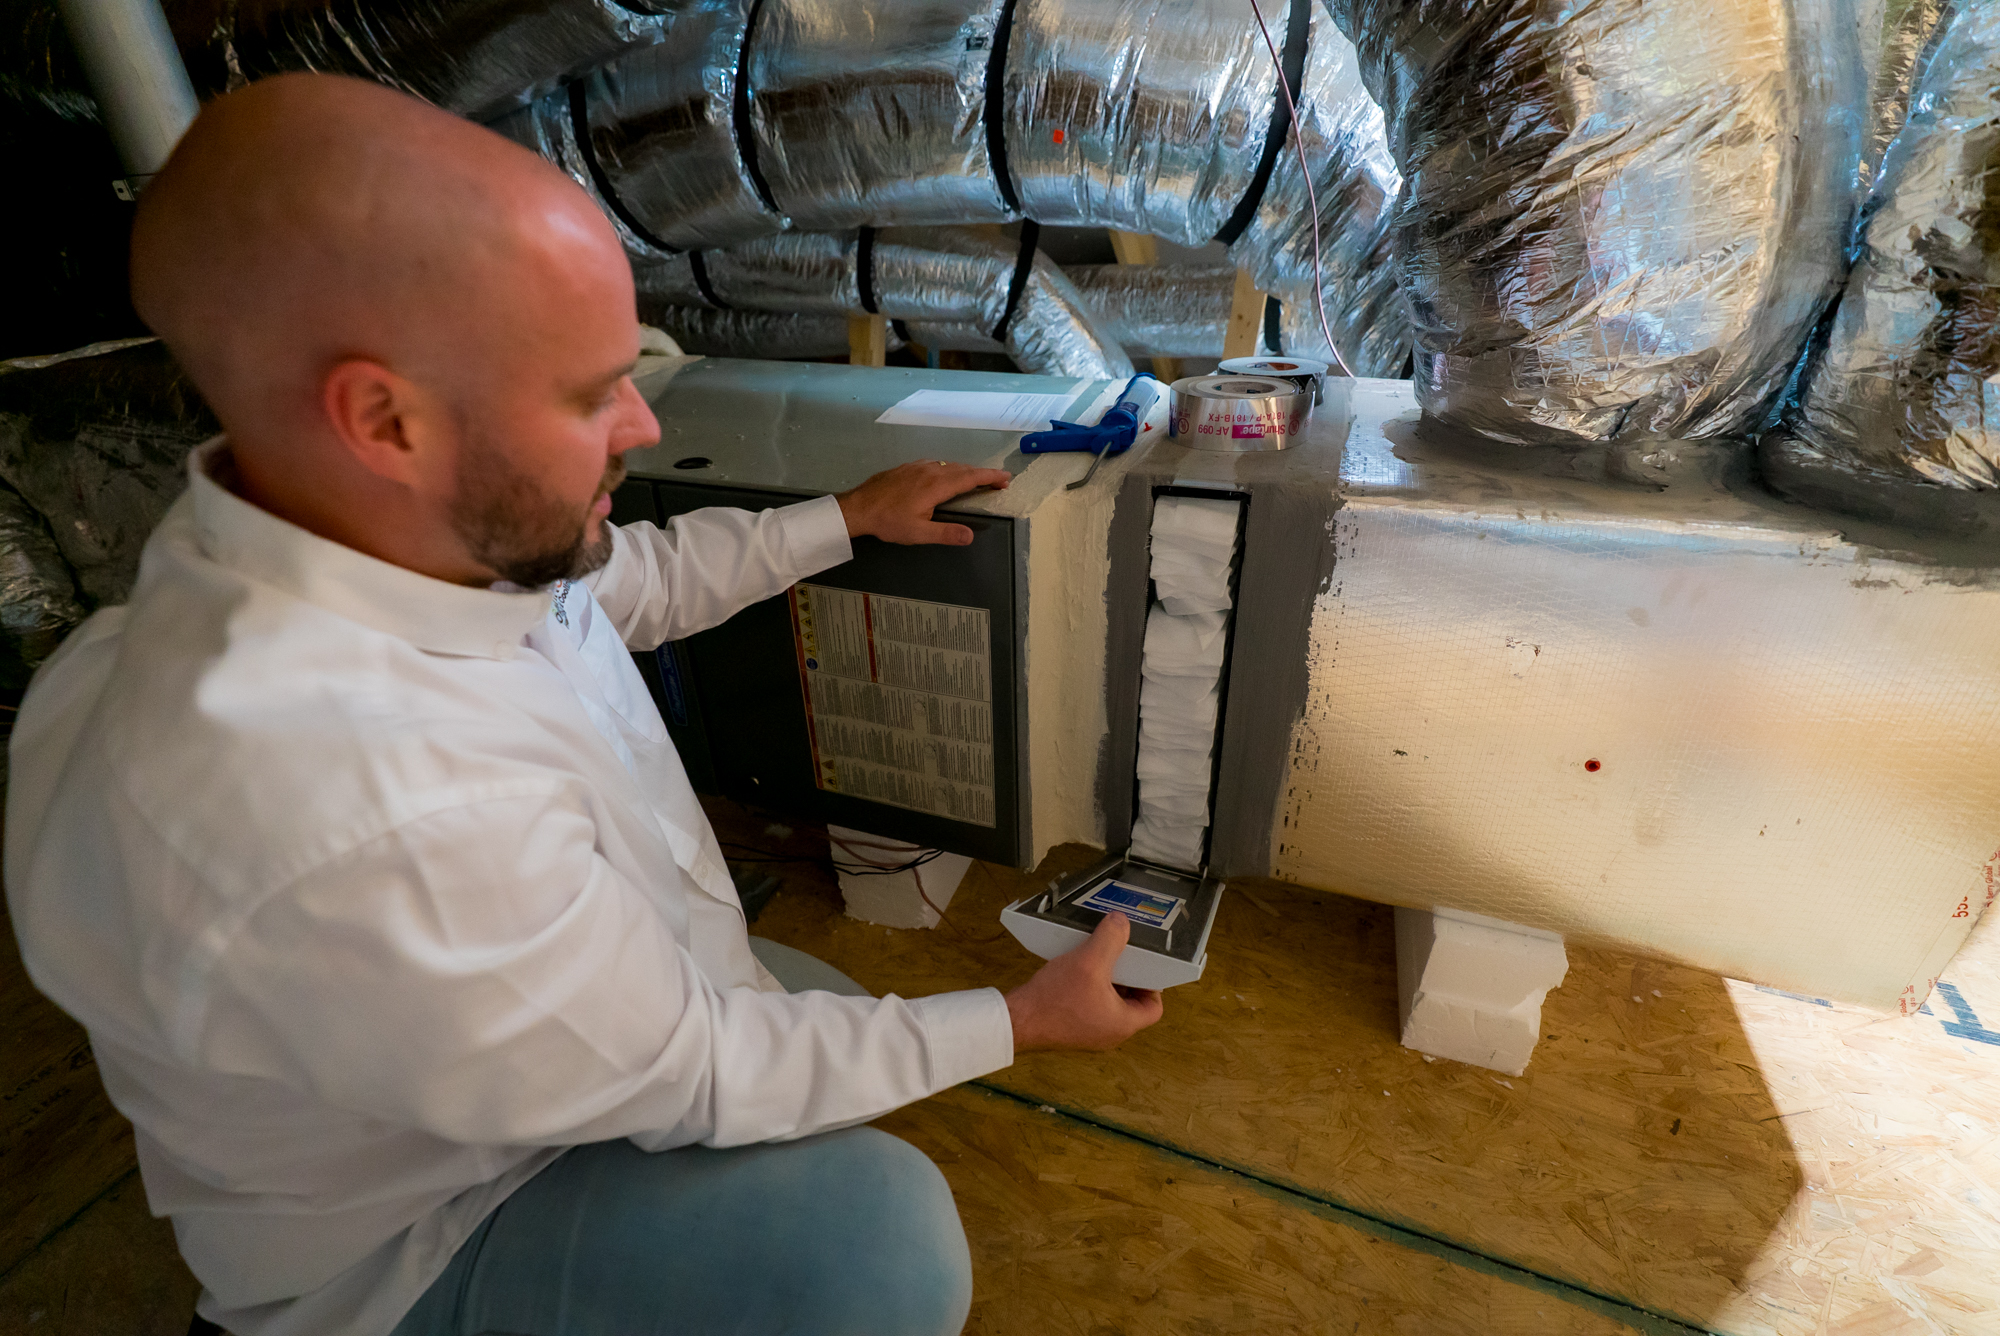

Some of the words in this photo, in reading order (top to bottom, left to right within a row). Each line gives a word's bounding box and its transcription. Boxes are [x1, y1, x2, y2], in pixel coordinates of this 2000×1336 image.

[1208, 413, 1247, 423] 181B-FX
[1256, 411, 1286, 423] 181A-P
[1198, 424, 1214, 435] 099
[1215, 426, 1230, 436] AF
[1242, 424, 1286, 437] Shurtape
[1984, 865, 1993, 883] Global
[1985, 884, 1995, 900] Berry
